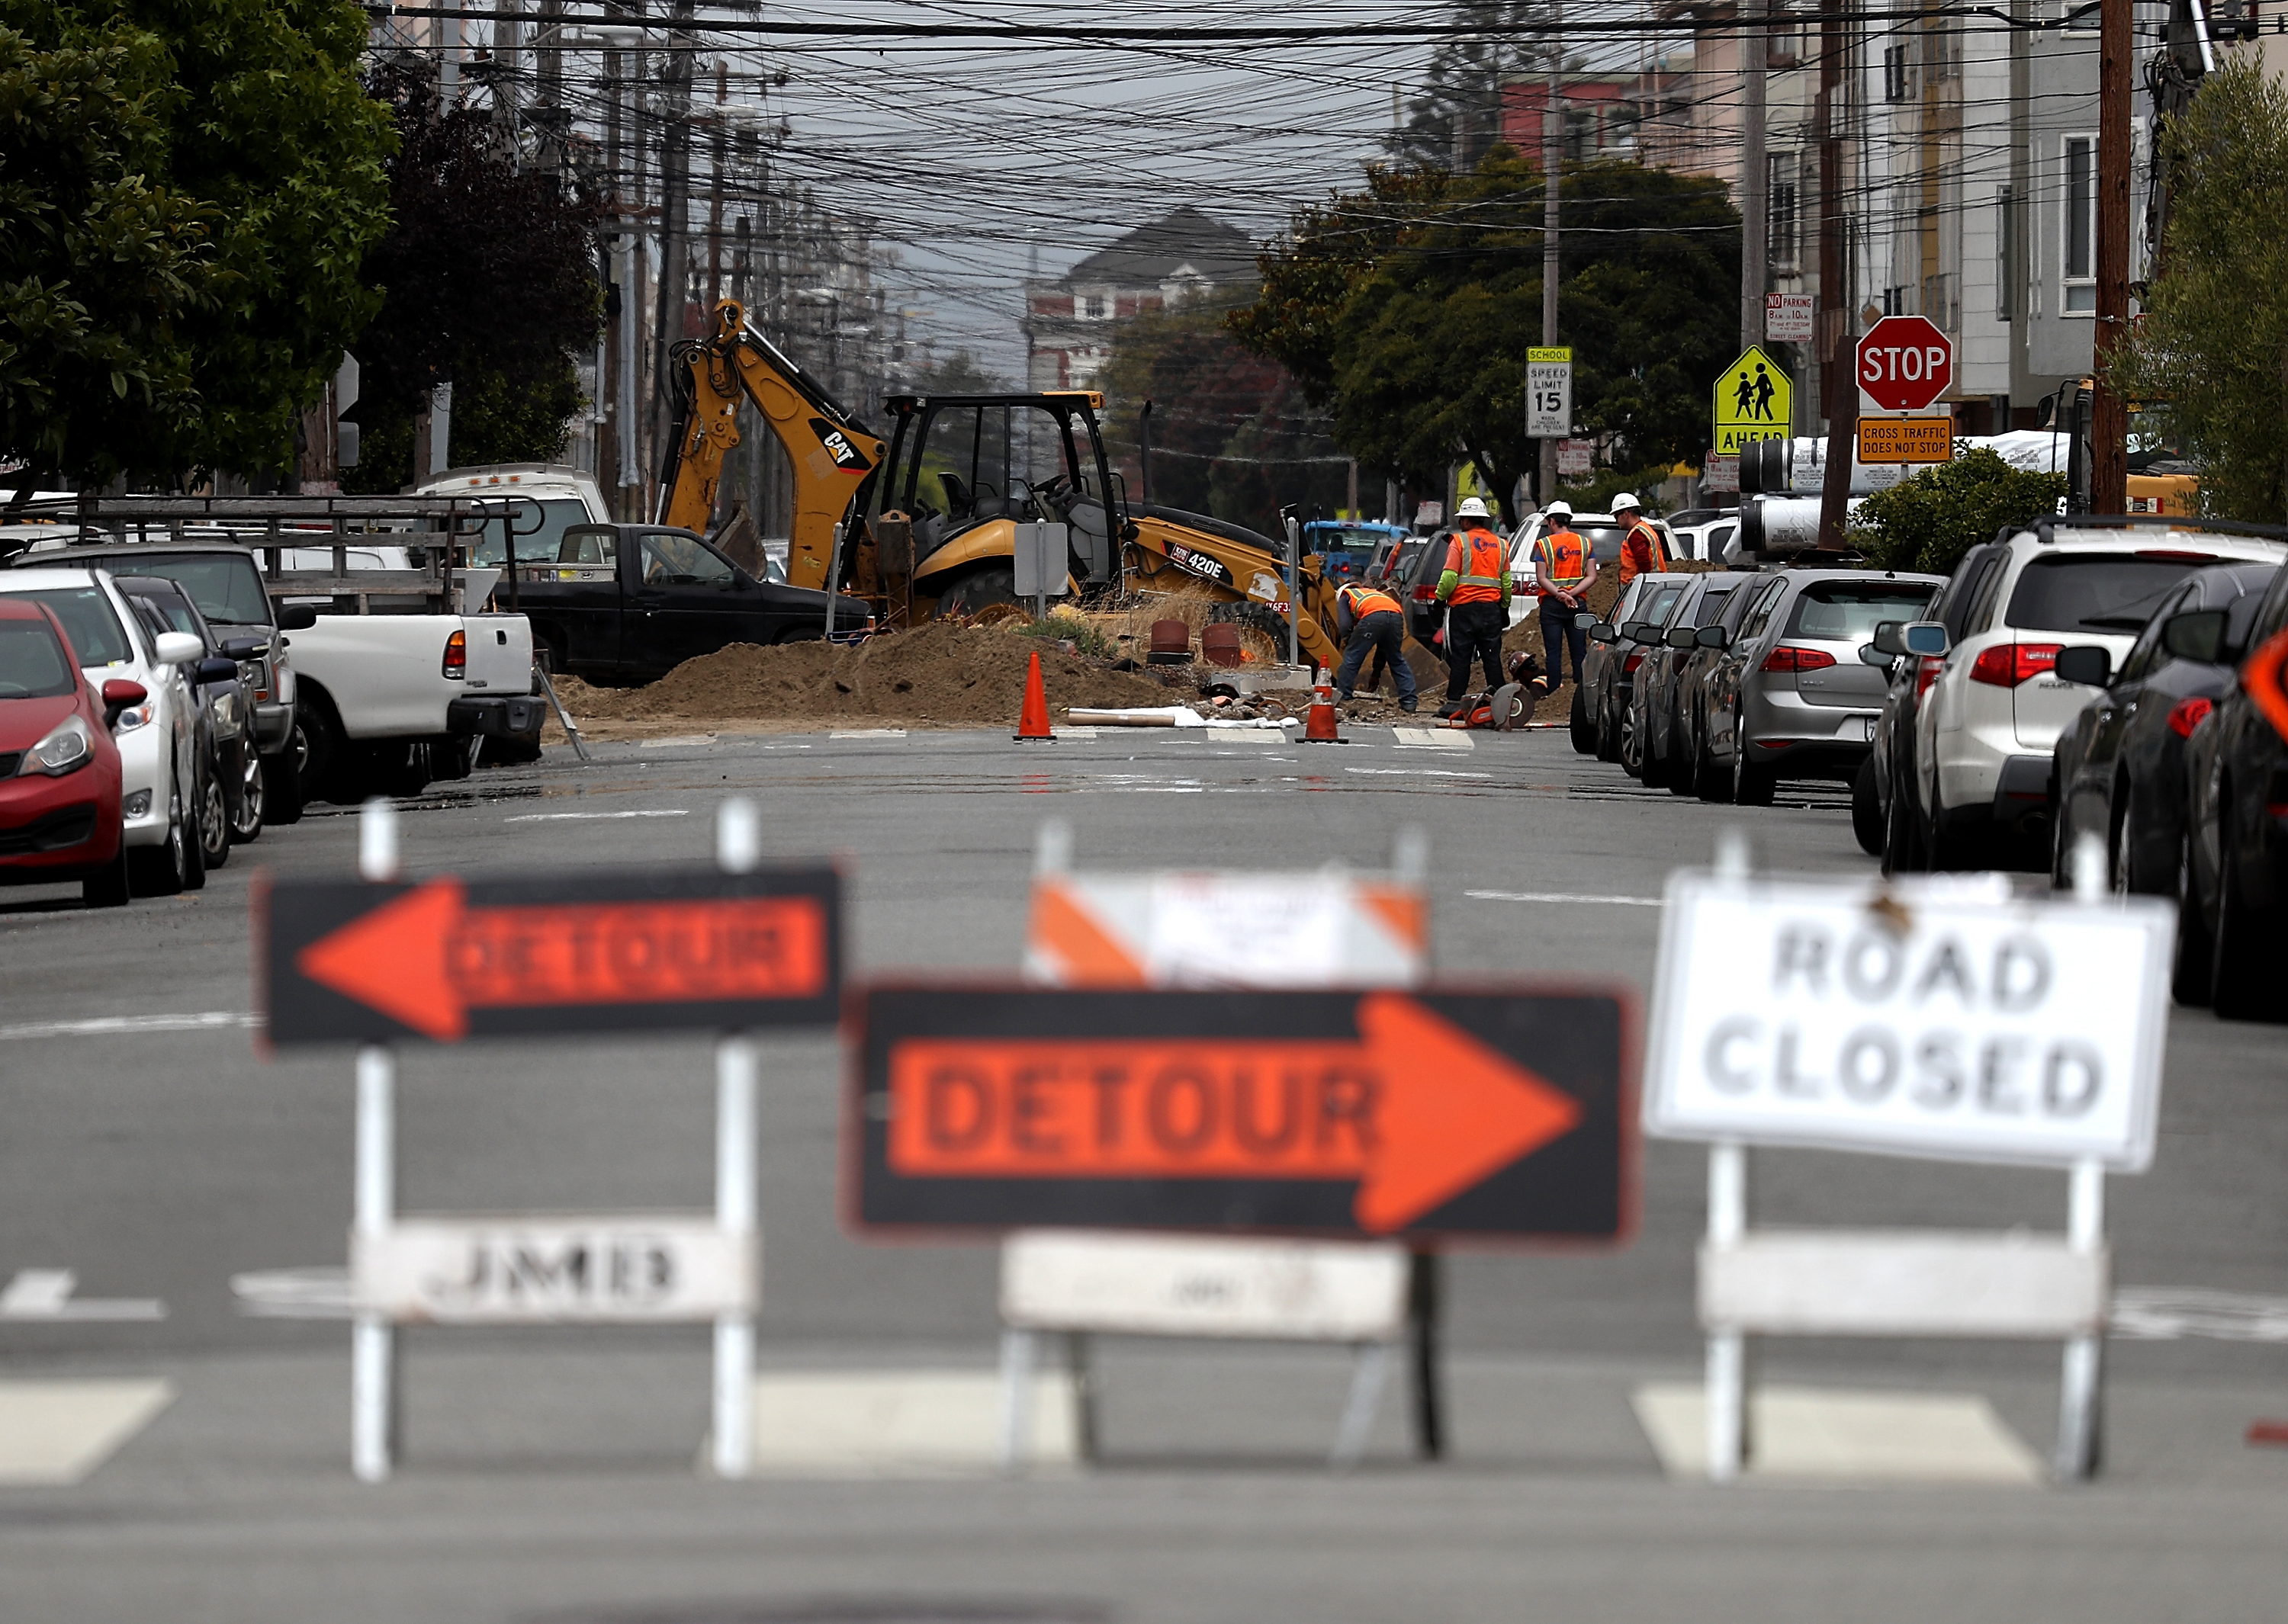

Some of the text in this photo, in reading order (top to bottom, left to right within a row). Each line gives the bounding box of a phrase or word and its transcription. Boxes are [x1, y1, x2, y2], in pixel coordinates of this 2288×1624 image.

[1768, 295, 1811, 307] NO PARKING
[1530, 351, 1567, 359] SCHOOL
[1863, 347, 1946, 381] STOP
[1531, 368, 1567, 378] SPEED
[1534, 380, 1562, 389] LIMIT
[1535, 391, 1561, 412] 15
[1864, 427, 1946, 439] CROSS TRAFFIC
[824, 432, 854, 464] CAT
[1864, 442, 1946, 453] DOES NOT STOP
[1176, 547, 1189, 557] US
[1188, 554, 1223, 578] 420E
[446, 920, 786, 984] DETOUR
[1773, 920, 2055, 1015] ROAD
[1702, 1014, 2106, 1120] CLOSED
[925, 1064, 1382, 1155] DETOUR
[422, 1240, 677, 1301] JMB
